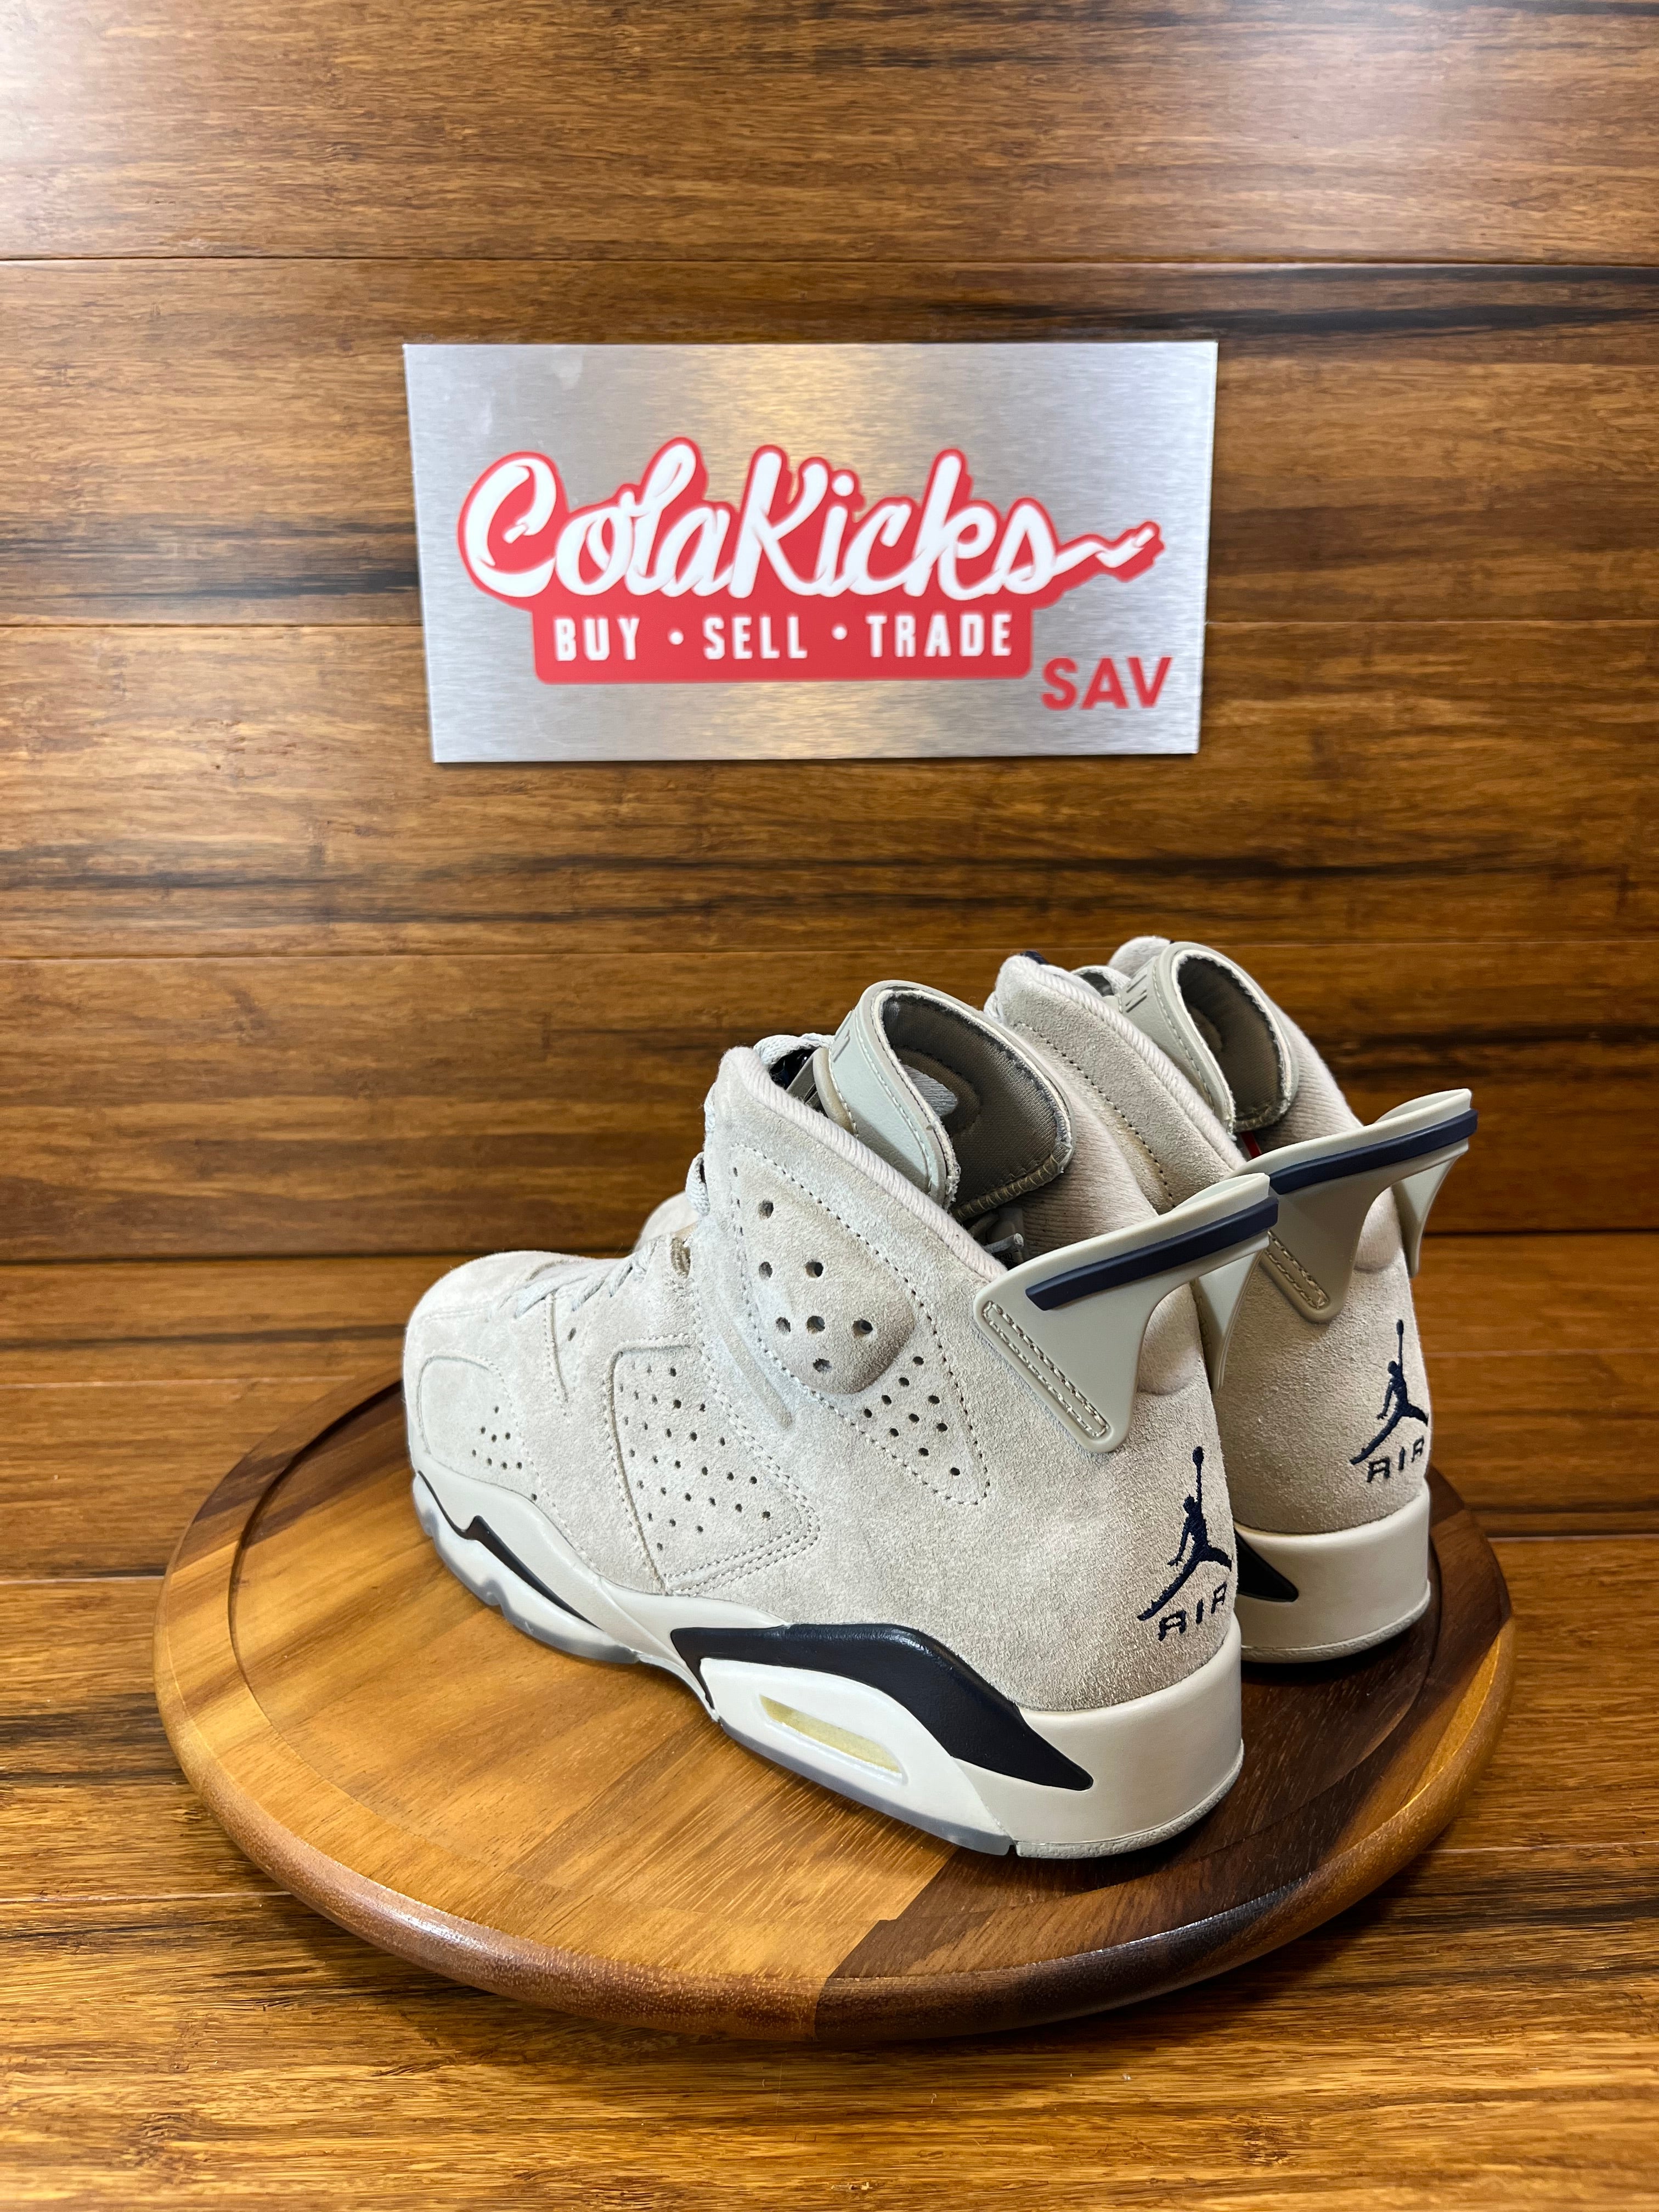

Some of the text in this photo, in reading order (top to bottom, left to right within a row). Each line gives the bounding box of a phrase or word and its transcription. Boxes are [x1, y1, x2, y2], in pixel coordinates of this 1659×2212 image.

[464, 444, 1154, 600] ColaKicks
[554, 613, 1012, 662] BUY SELL TRADE
[1042, 657, 1172, 710] SAV
[1367, 1435, 1425, 1482] AIR
[1158, 1581, 1227, 1641] AIR
